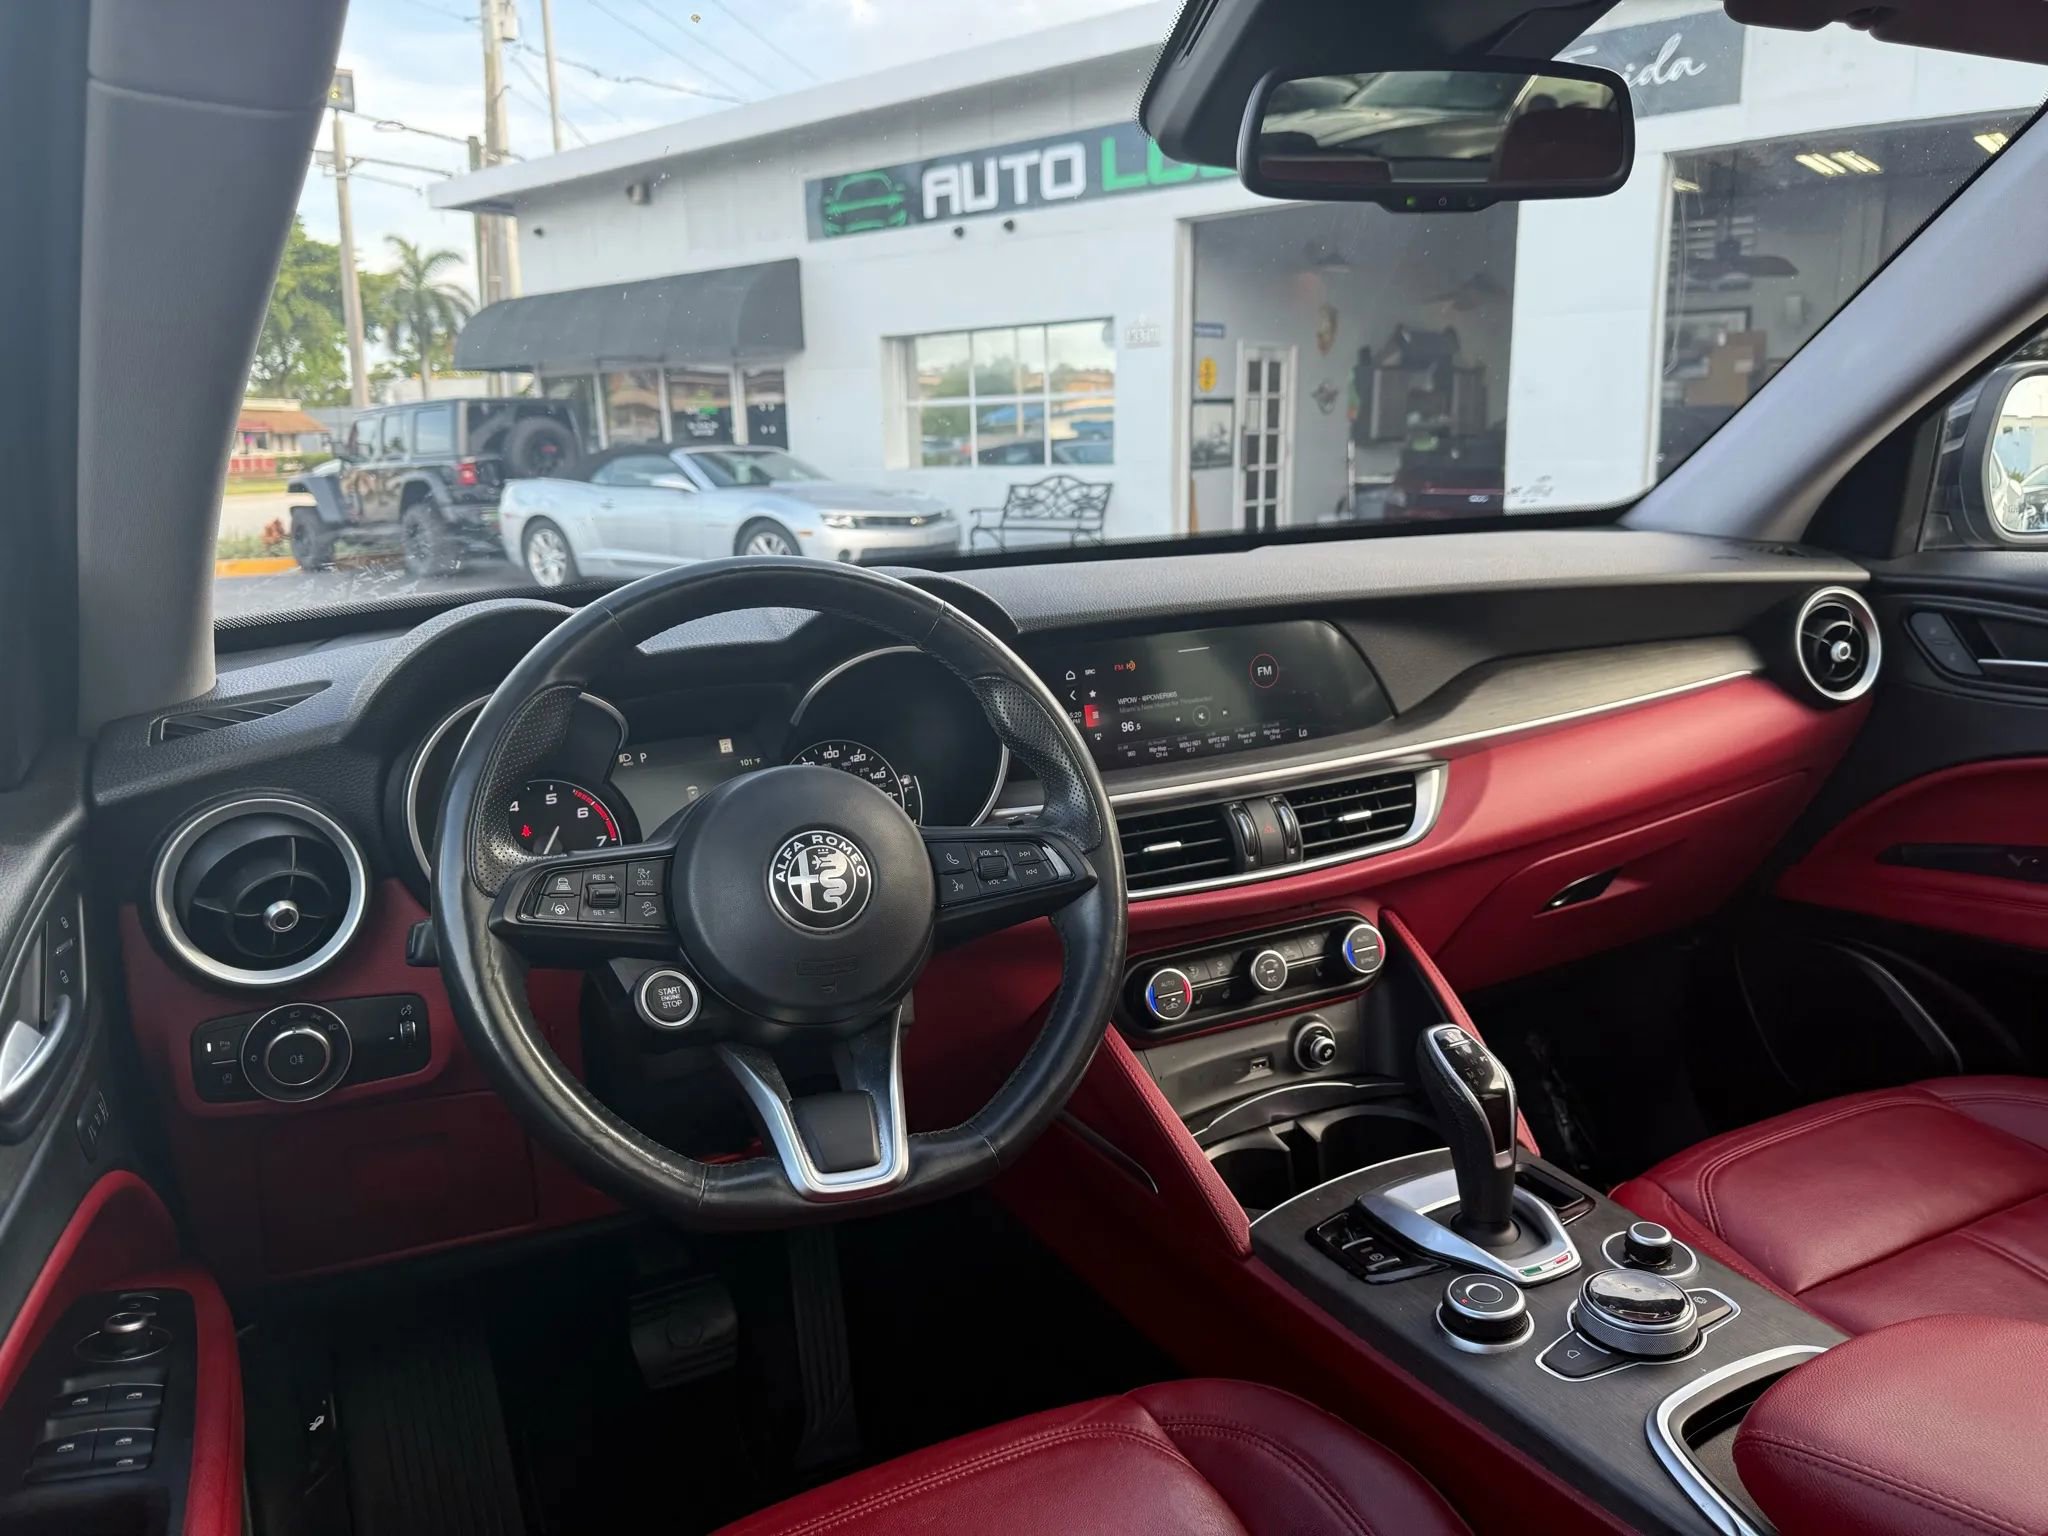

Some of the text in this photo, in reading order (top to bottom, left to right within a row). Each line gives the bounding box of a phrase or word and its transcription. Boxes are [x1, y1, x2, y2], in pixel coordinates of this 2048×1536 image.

[922, 142, 1087, 219] AUTO
[1257, 665, 1272, 676] FM
[1117, 697, 1138, 705] WPOW
[1121, 721, 1142, 733] 96.5
[1298, 728, 1308, 738] Lo
[640, 752, 647, 763] P
[823, 750, 839, 759] 100
[850, 753, 866, 763] 120
[740, 758, 753, 766] 101
[870, 770, 886, 780] 140
[545, 793, 558, 805] 5
[509, 801, 520, 812] 4
[577, 807, 589, 819] 6
[596, 835, 607, 847] 7
[980, 849, 991, 857] VOL
[775, 834, 867, 883] ALFA ROMEO
[592, 873, 607, 881] RES
[657, 985, 682, 996] START
[660, 993, 681, 1002] ENGINE
[662, 999, 683, 1009] STOP
